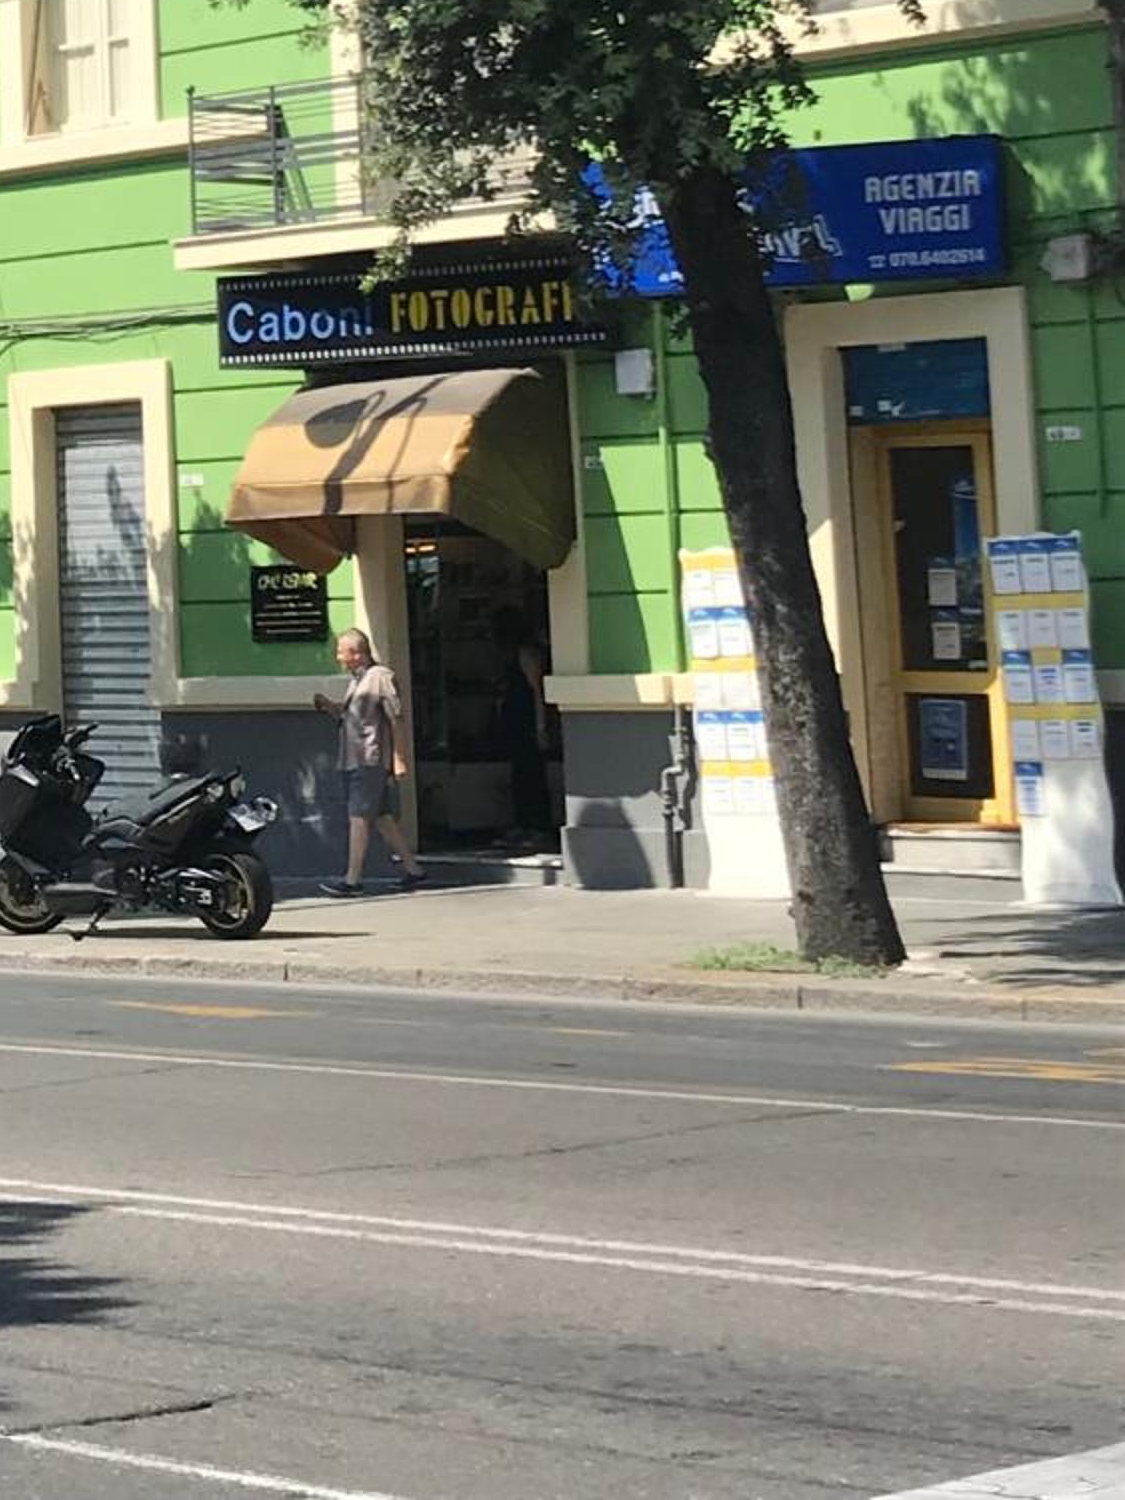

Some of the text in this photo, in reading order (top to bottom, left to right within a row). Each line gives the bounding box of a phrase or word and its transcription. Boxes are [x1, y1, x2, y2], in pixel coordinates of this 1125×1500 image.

[864, 169, 981, 203] AGENZIA
[878, 203, 971, 235] VIAGGI
[226, 299, 373, 343] Caboni
